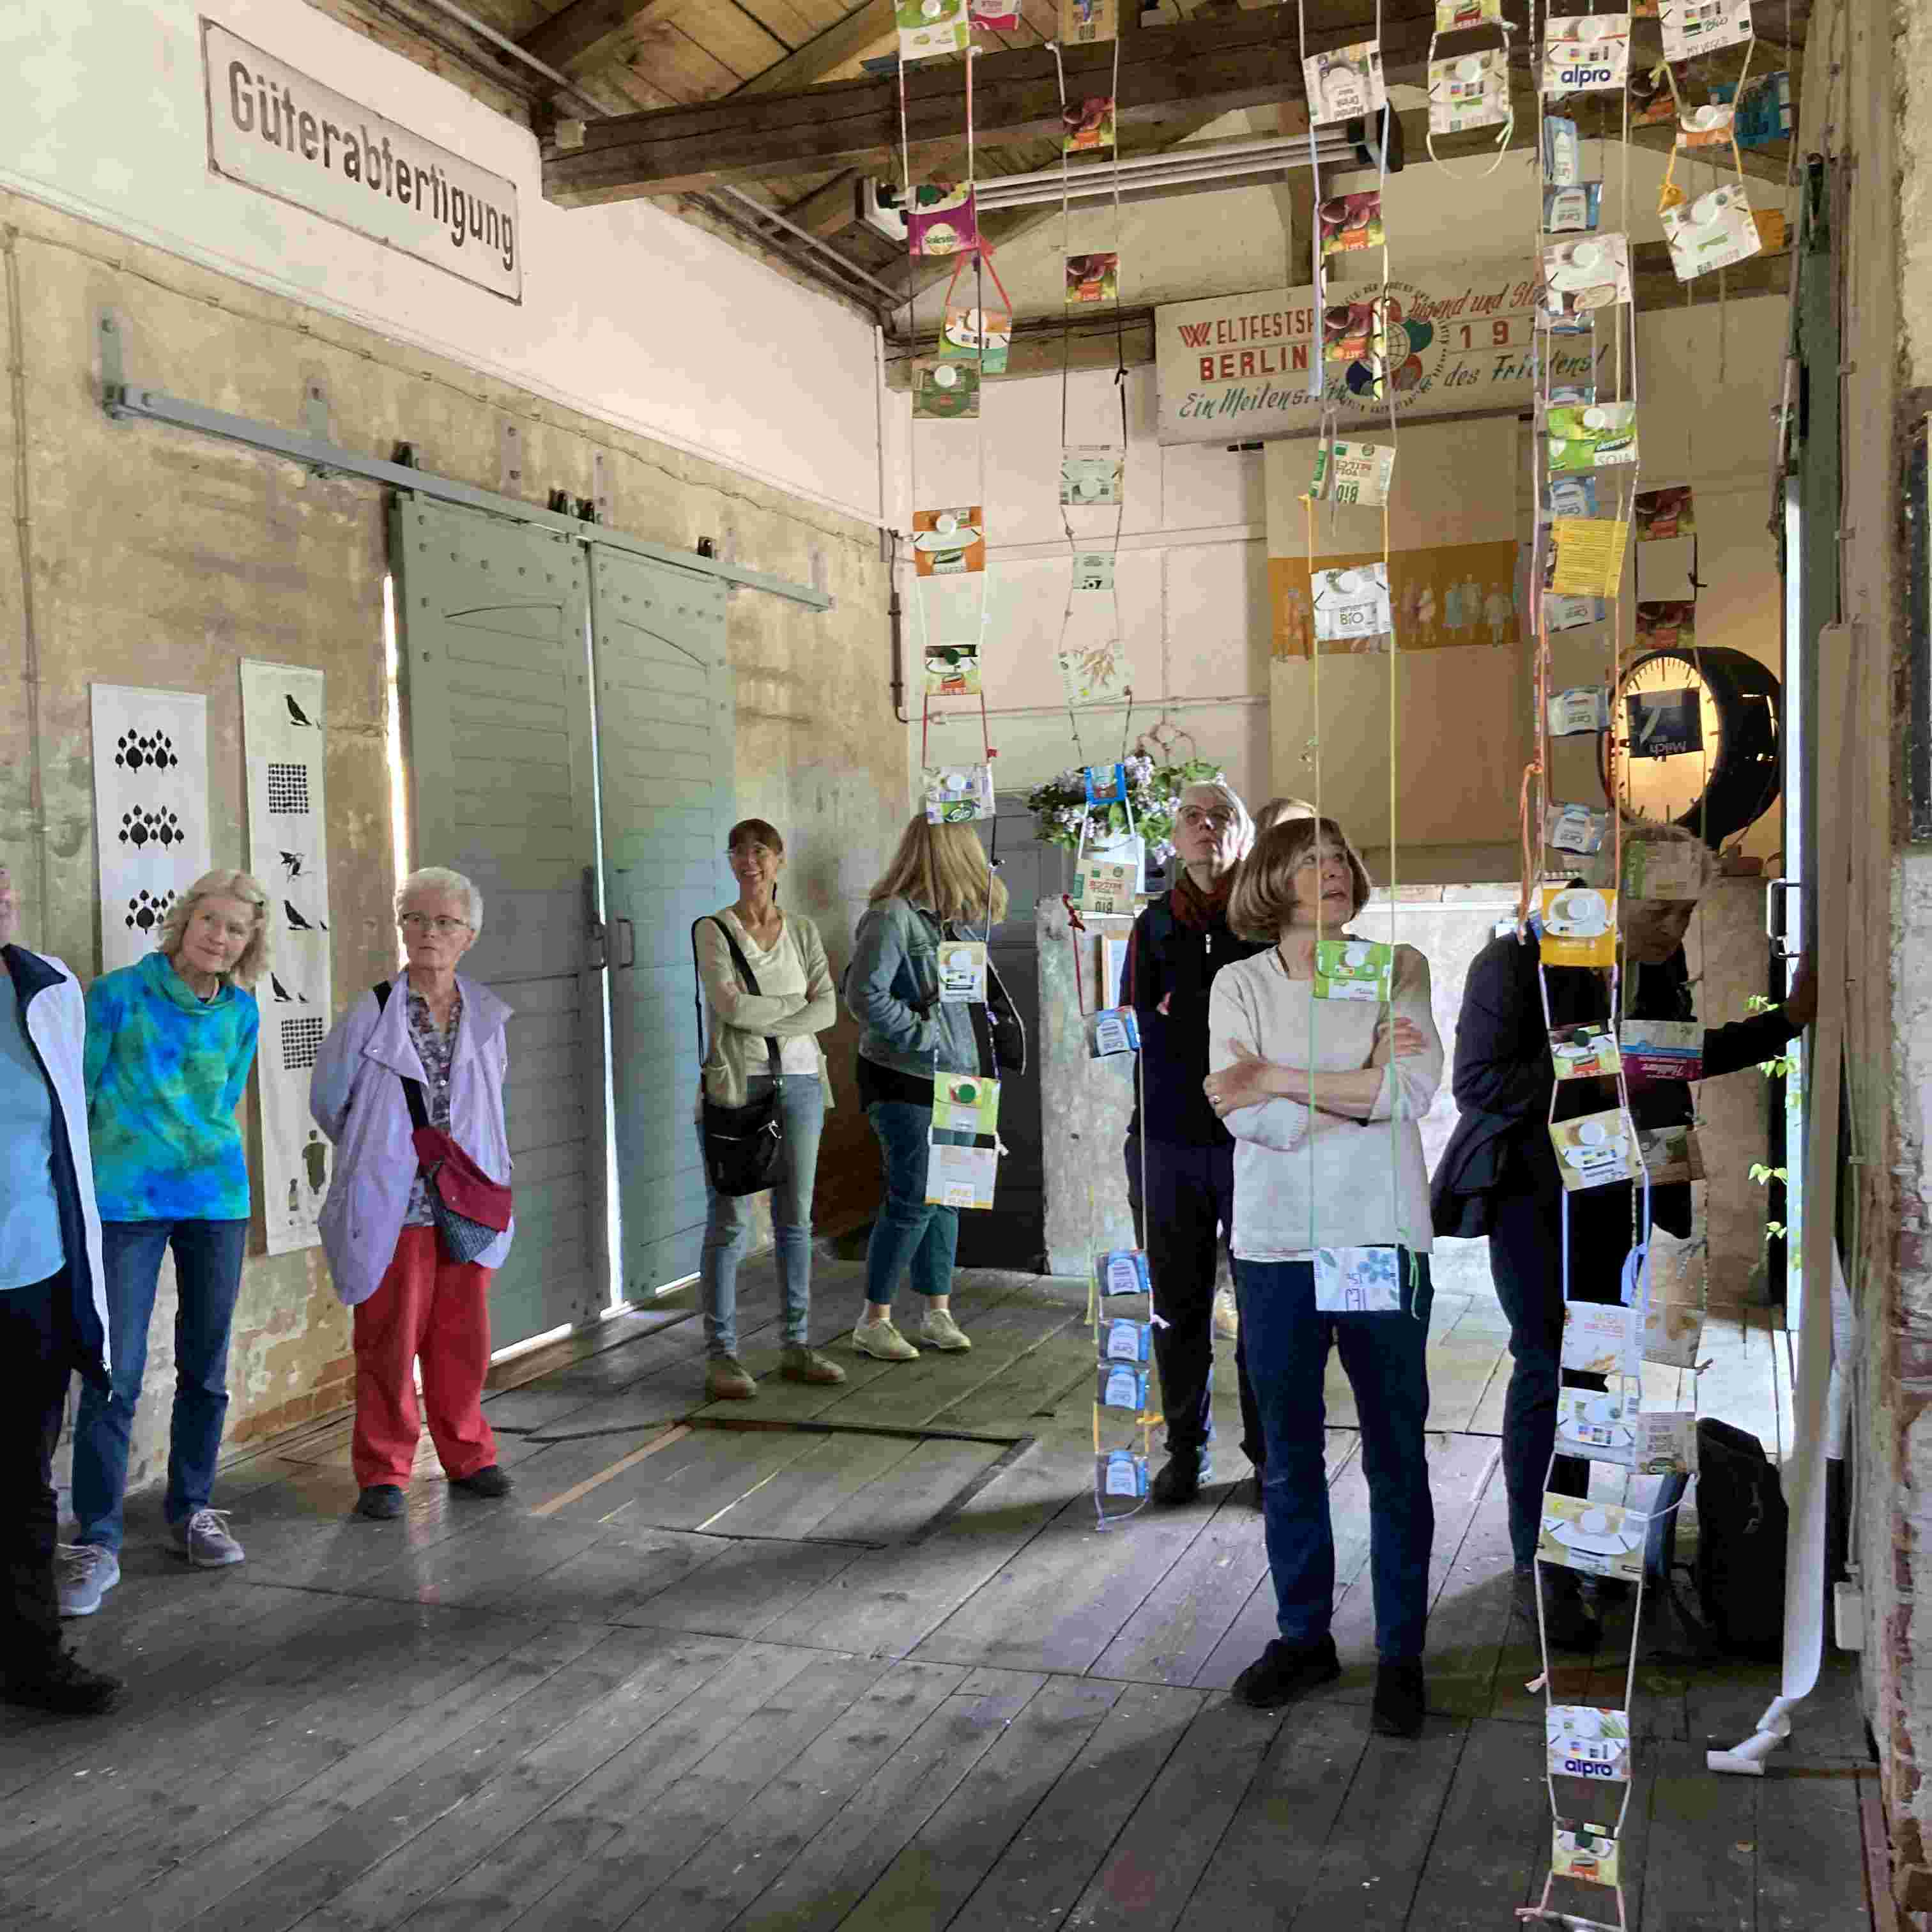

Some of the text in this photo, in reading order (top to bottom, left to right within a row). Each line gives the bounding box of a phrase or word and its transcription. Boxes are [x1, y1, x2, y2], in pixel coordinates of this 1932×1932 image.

[1561, 65, 1611, 87] alpro
[229, 61, 514, 270] Güterabfertigung
[1470, 282, 1510, 314] und
[1200, 345, 1308, 381] BERLIN
[1179, 392, 1216, 418] Ein
[1444, 360, 1480, 387] des
[1565, 1759, 1613, 1778] alpro
